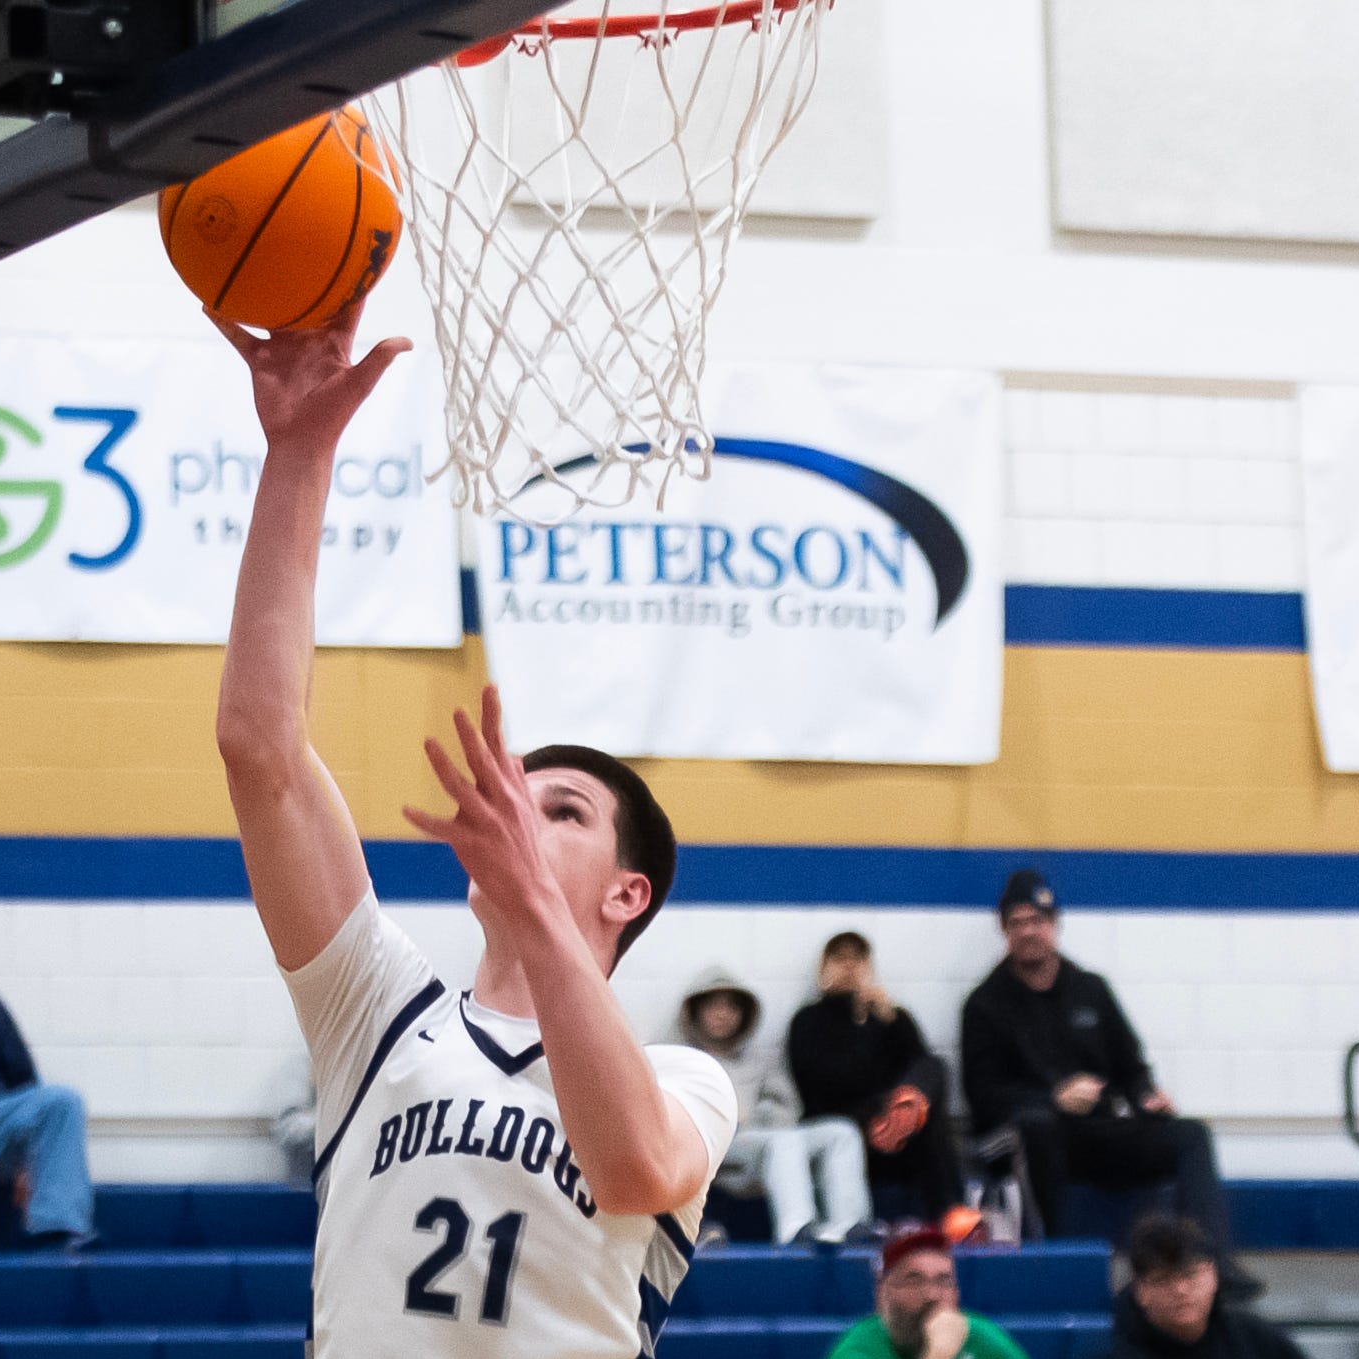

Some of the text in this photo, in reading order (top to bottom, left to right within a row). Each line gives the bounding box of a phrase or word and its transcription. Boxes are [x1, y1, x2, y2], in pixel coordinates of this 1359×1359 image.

[171, 440, 423, 508] phcal
[195, 516, 402, 556] thapy
[497, 519, 912, 591] PETERSON
[494, 587, 906, 641] Accounting Group
[403, 1195, 528, 1328] 21
